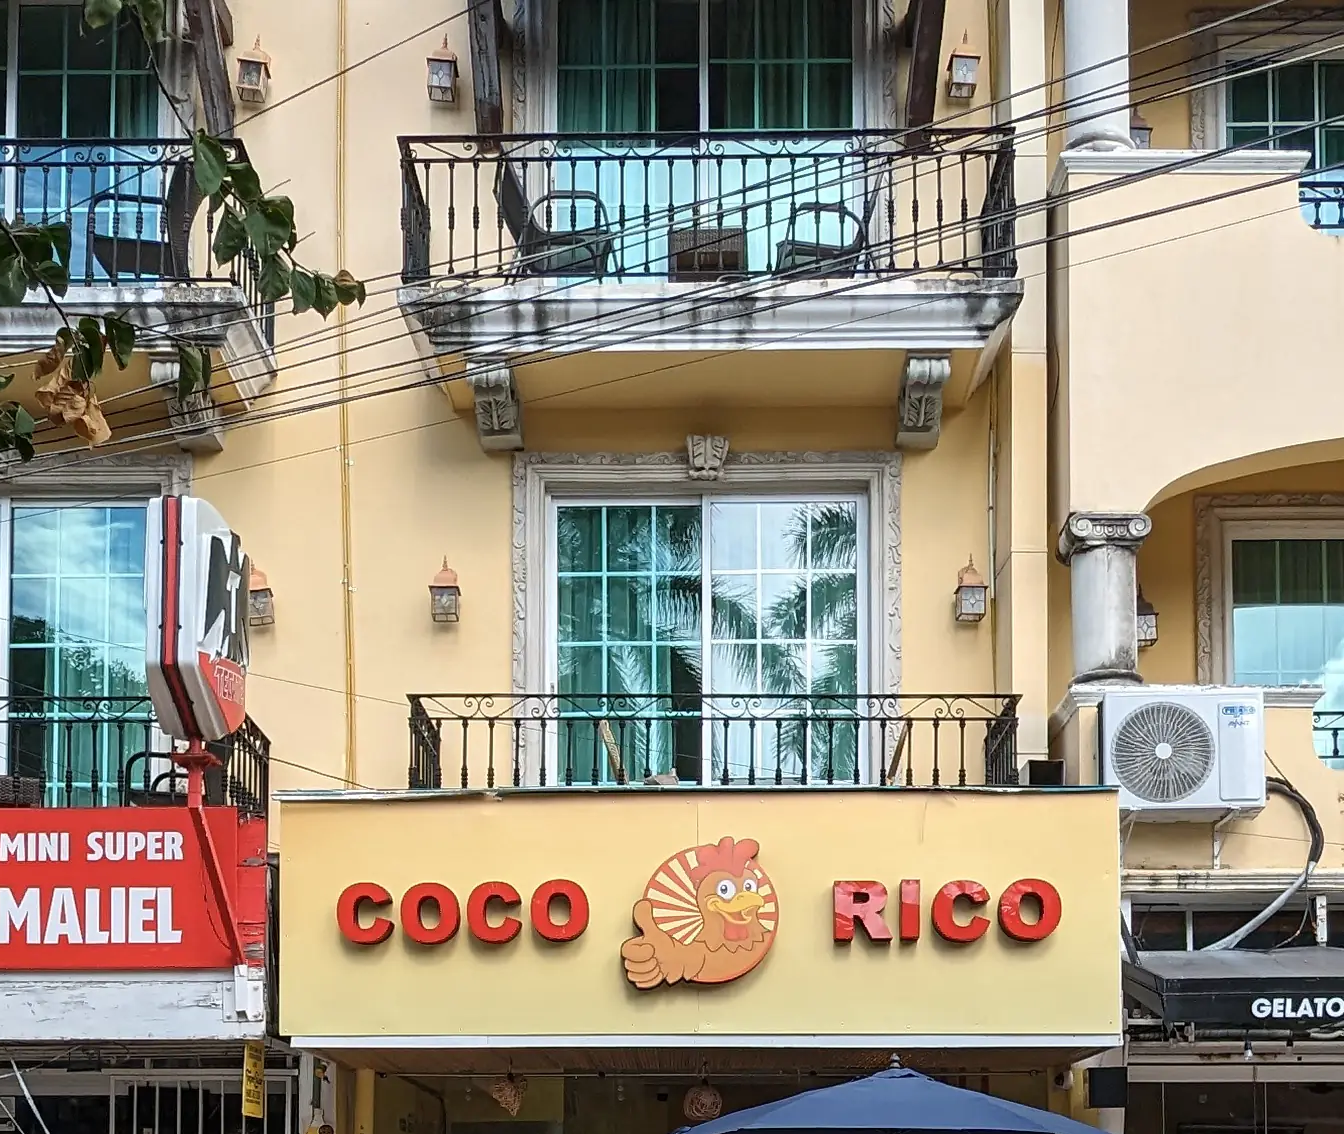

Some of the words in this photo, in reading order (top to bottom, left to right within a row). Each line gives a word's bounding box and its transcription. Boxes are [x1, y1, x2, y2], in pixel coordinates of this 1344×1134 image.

[0, 832, 70, 862] MINI
[86, 831, 184, 861] SUPER
[336, 878, 591, 945] COCO
[832, 878, 1063, 943] RICO
